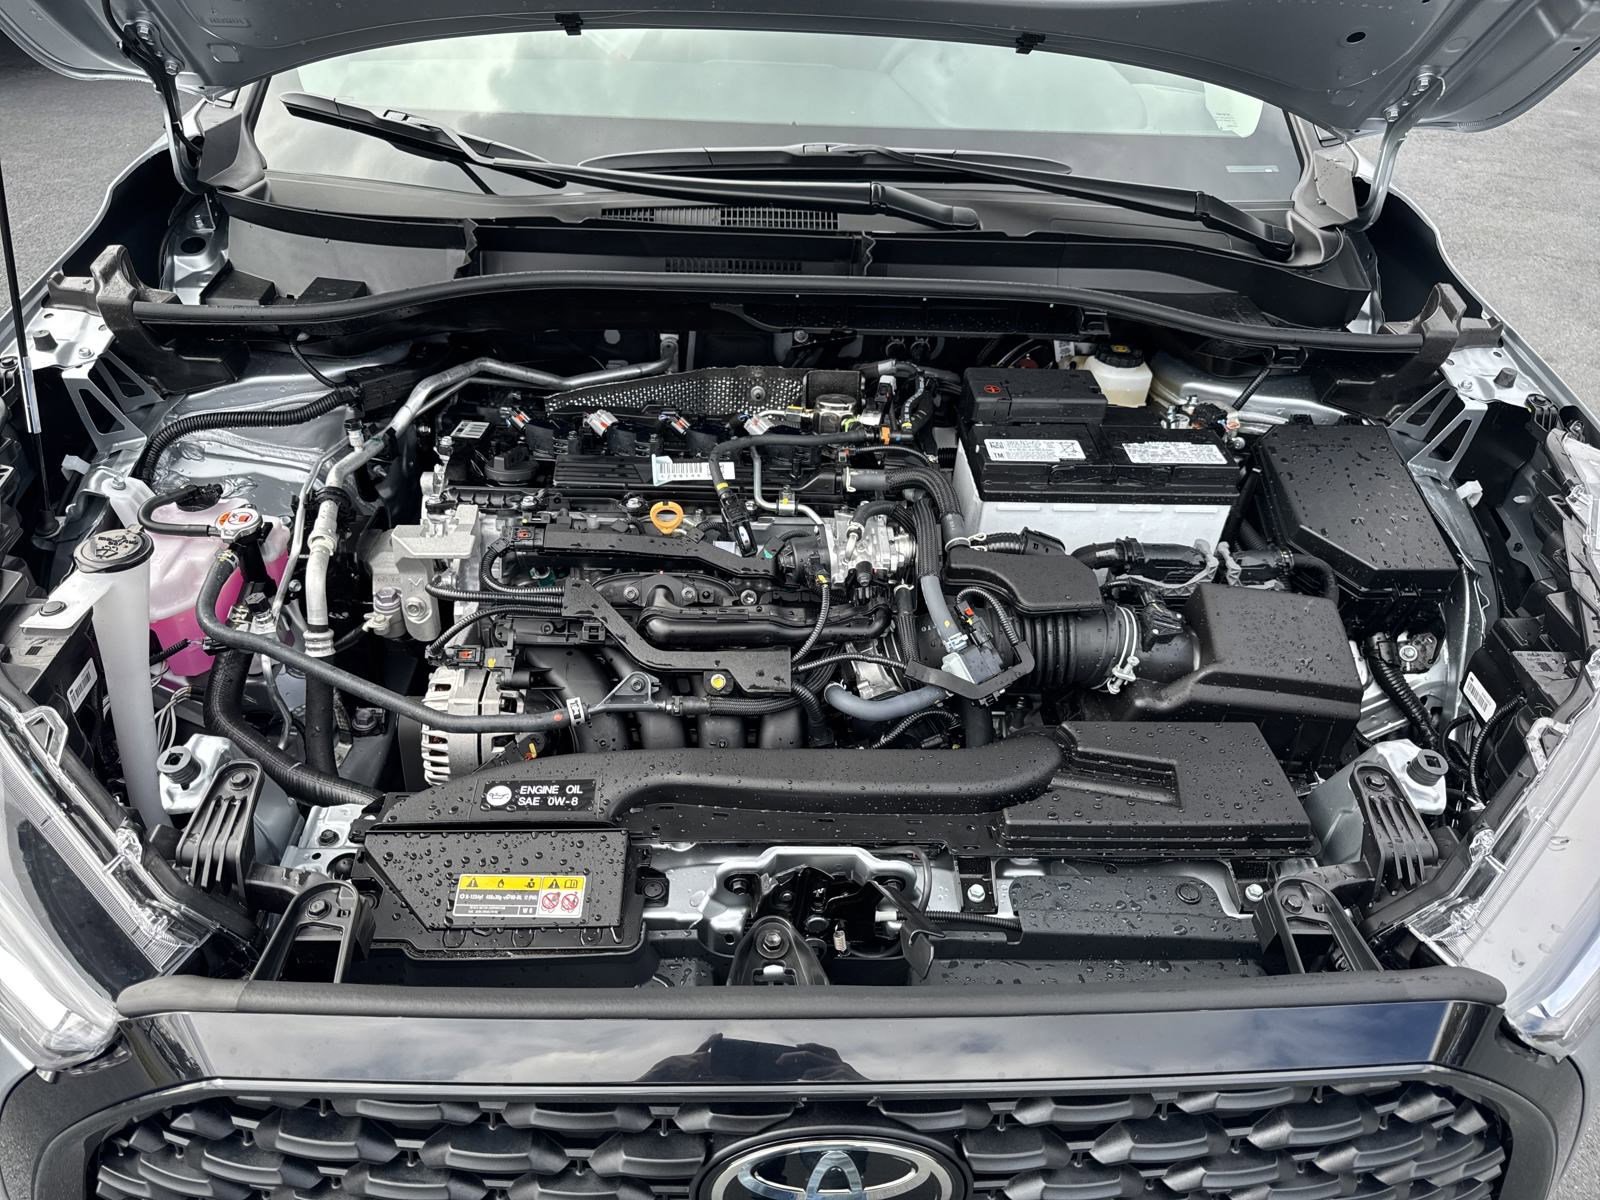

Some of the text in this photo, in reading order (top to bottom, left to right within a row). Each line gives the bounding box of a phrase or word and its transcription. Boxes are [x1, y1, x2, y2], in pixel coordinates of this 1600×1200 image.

[519, 784, 584, 795] ENGINE OIL
[517, 796, 579, 807] SAE 0W-8
